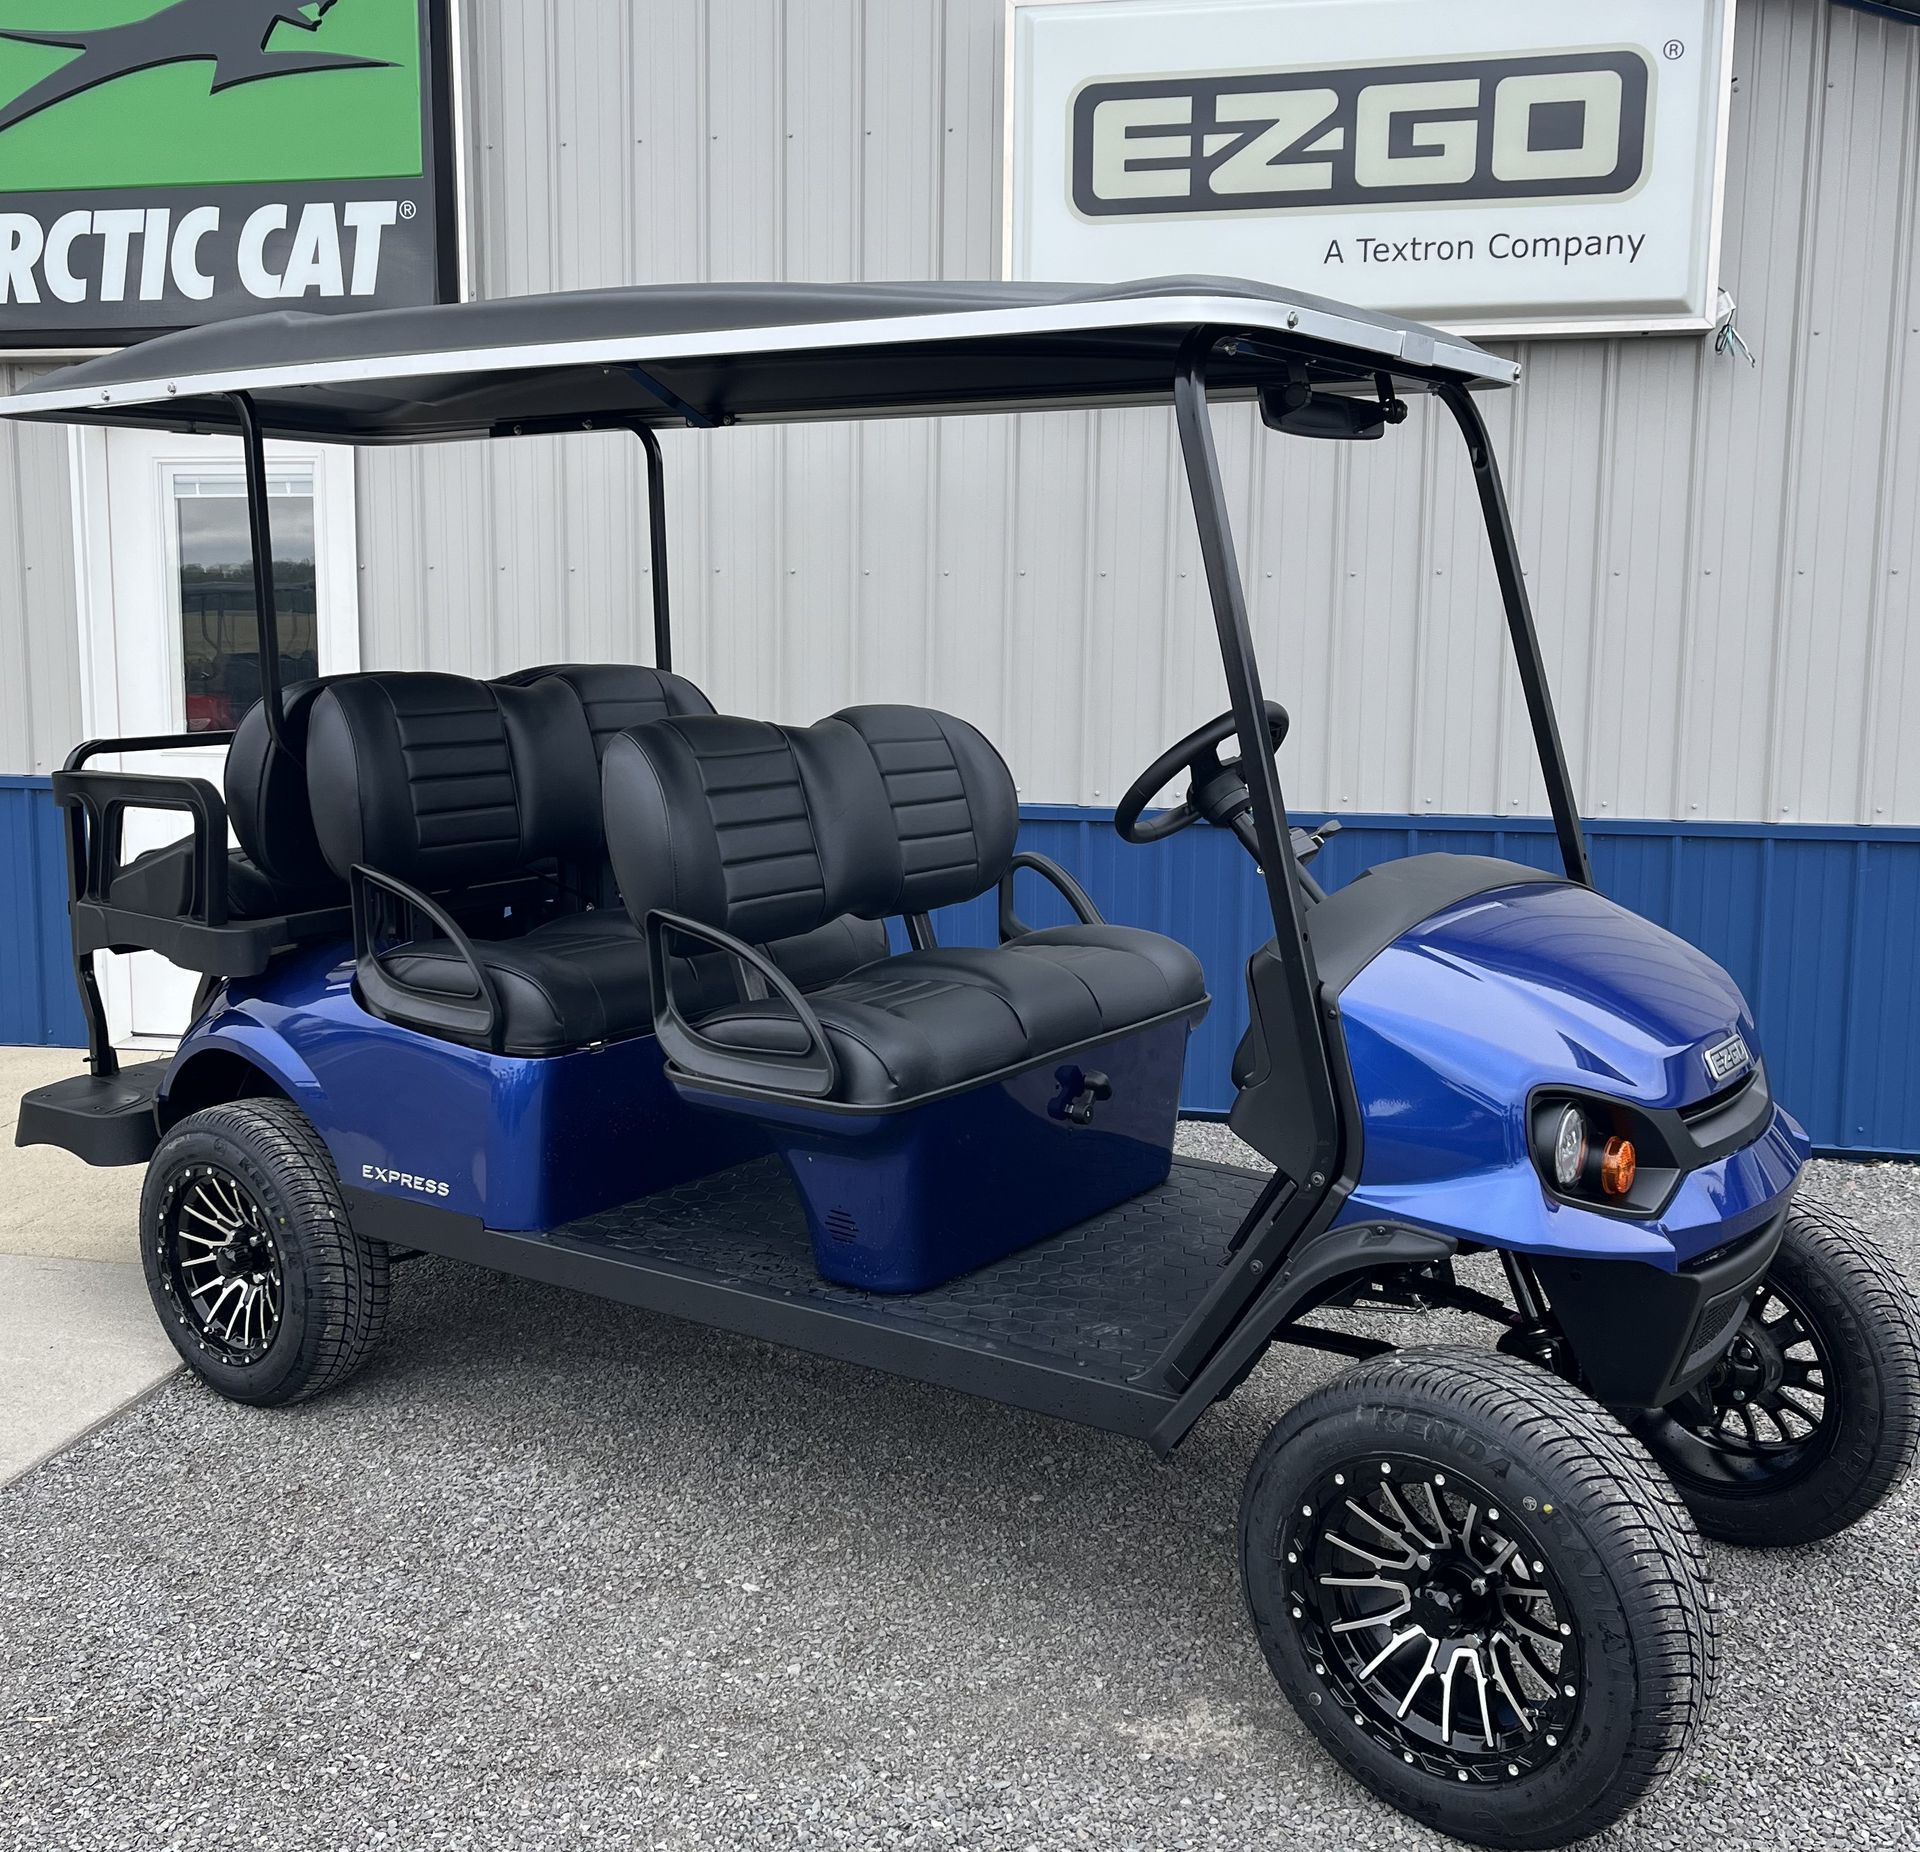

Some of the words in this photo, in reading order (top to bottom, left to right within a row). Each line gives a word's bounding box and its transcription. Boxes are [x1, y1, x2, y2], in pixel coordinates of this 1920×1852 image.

[1323, 239, 1344, 264] A
[1356, 236, 1474, 263] Textron
[1488, 233, 1646, 265] Company
[362, 1164, 450, 1197] EXPRESS
[1374, 1407, 1512, 1479] KENDA
